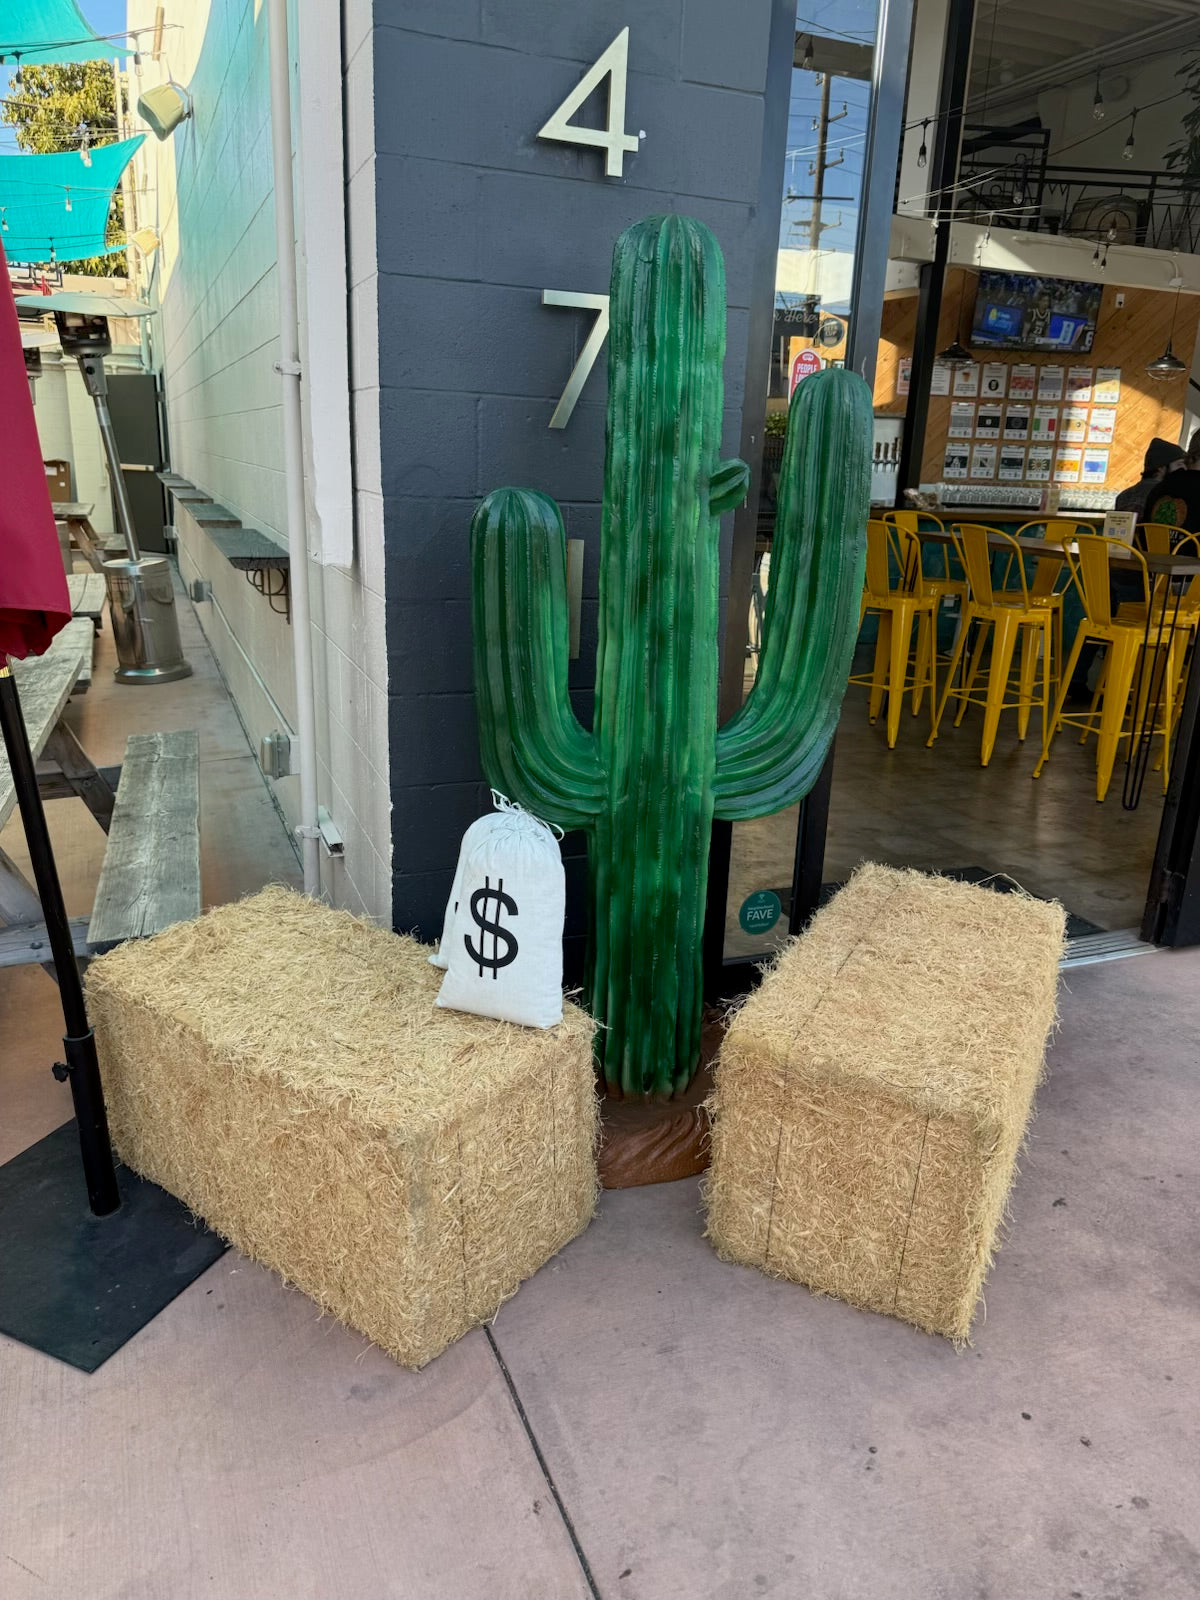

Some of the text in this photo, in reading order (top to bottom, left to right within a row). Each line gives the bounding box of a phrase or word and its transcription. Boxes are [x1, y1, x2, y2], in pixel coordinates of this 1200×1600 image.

[537, 26, 639, 177] 4
[542, 289, 610, 429] 7
[747, 909, 773, 921] FAVE
